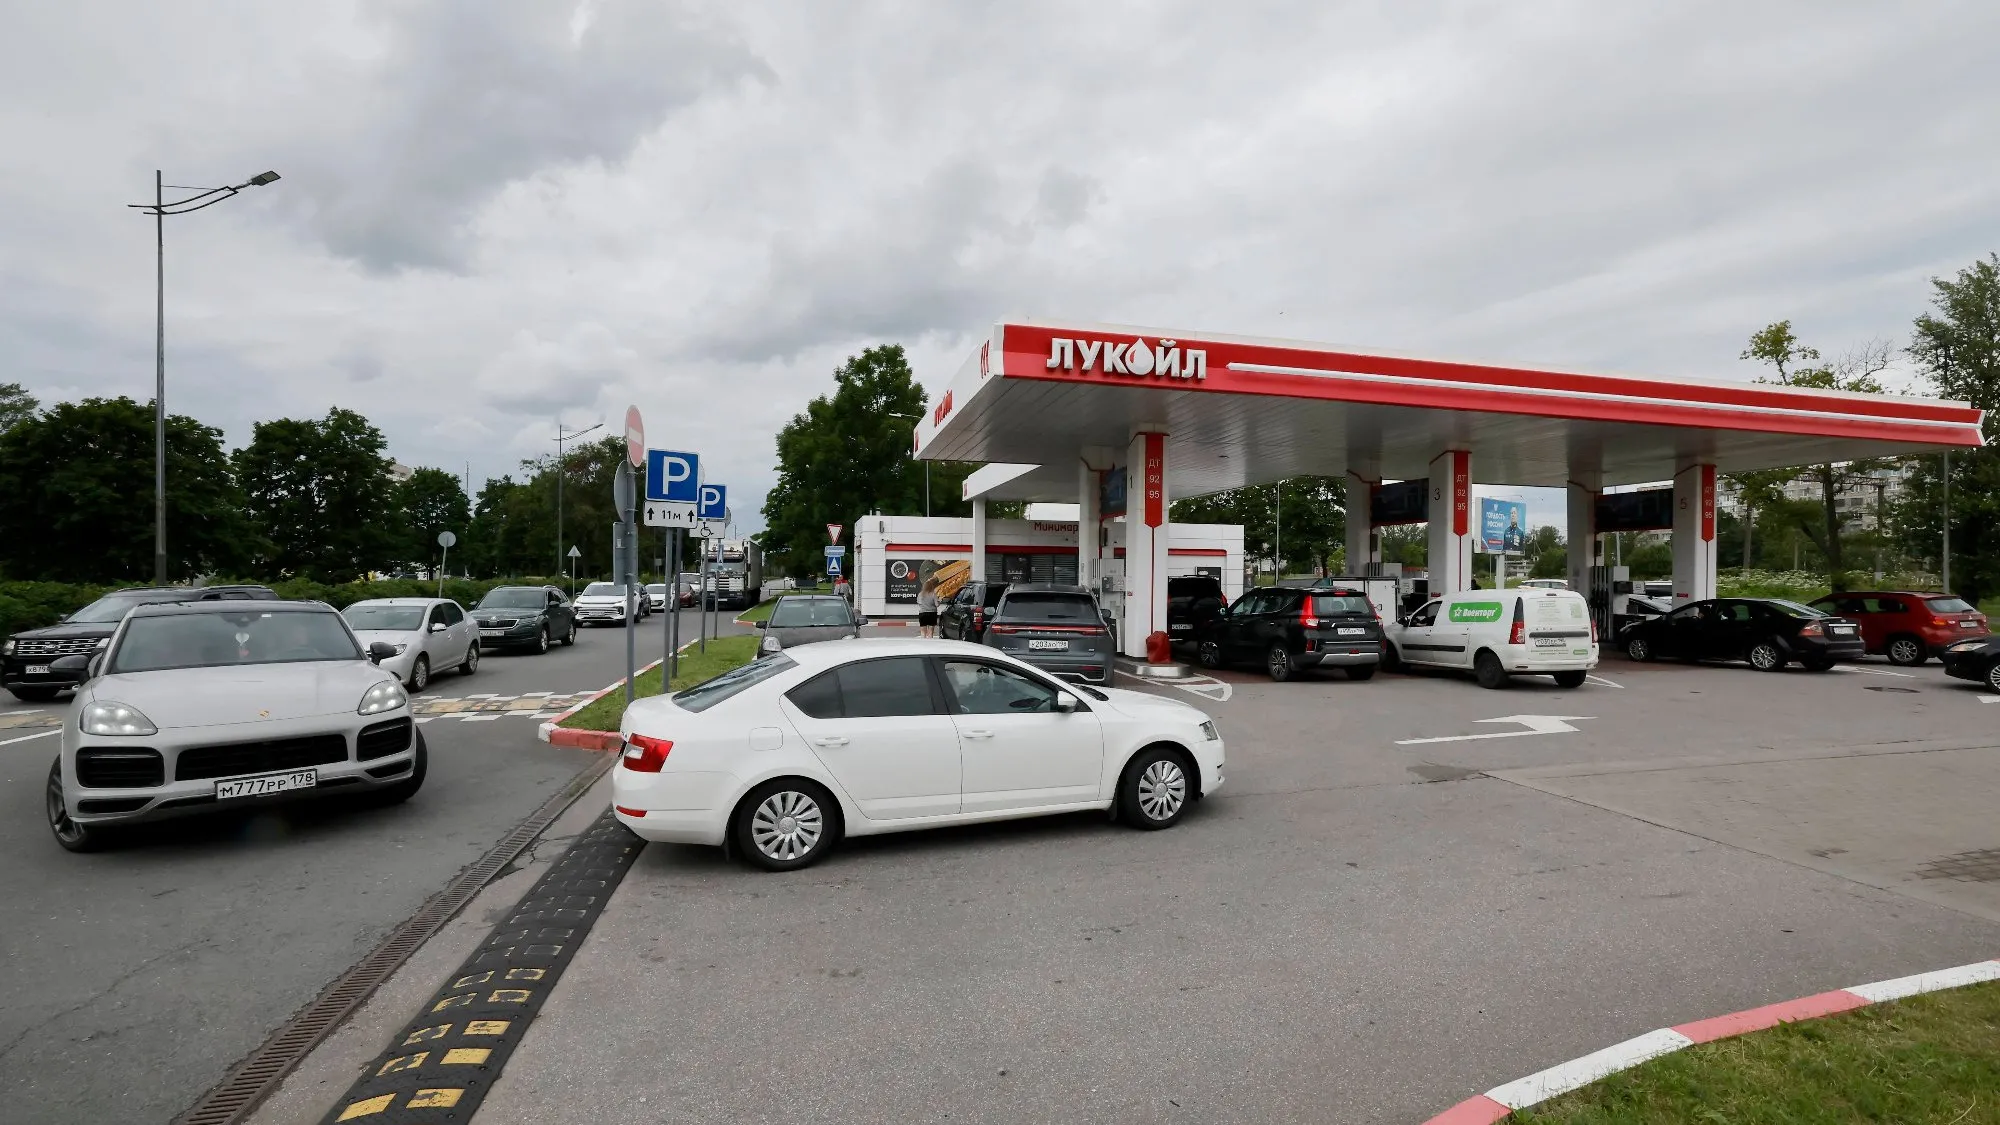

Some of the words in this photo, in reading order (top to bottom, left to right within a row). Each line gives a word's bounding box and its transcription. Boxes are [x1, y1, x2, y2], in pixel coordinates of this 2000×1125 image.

[1046, 337, 1207, 380] ЛУКОЙЛ
[662, 456, 691, 495] P
[1149, 474, 1160, 484] 92
[1149, 490, 1160, 499] 95
[1433, 487, 1441, 501] 3
[1457, 489, 1466, 497] 92
[700, 487, 721, 515] P
[1457, 502, 1466, 511] 95
[1704, 511, 1713, 519] 95
[222, 780, 286, 797] М777РР
[290, 773, 313, 785] 178
